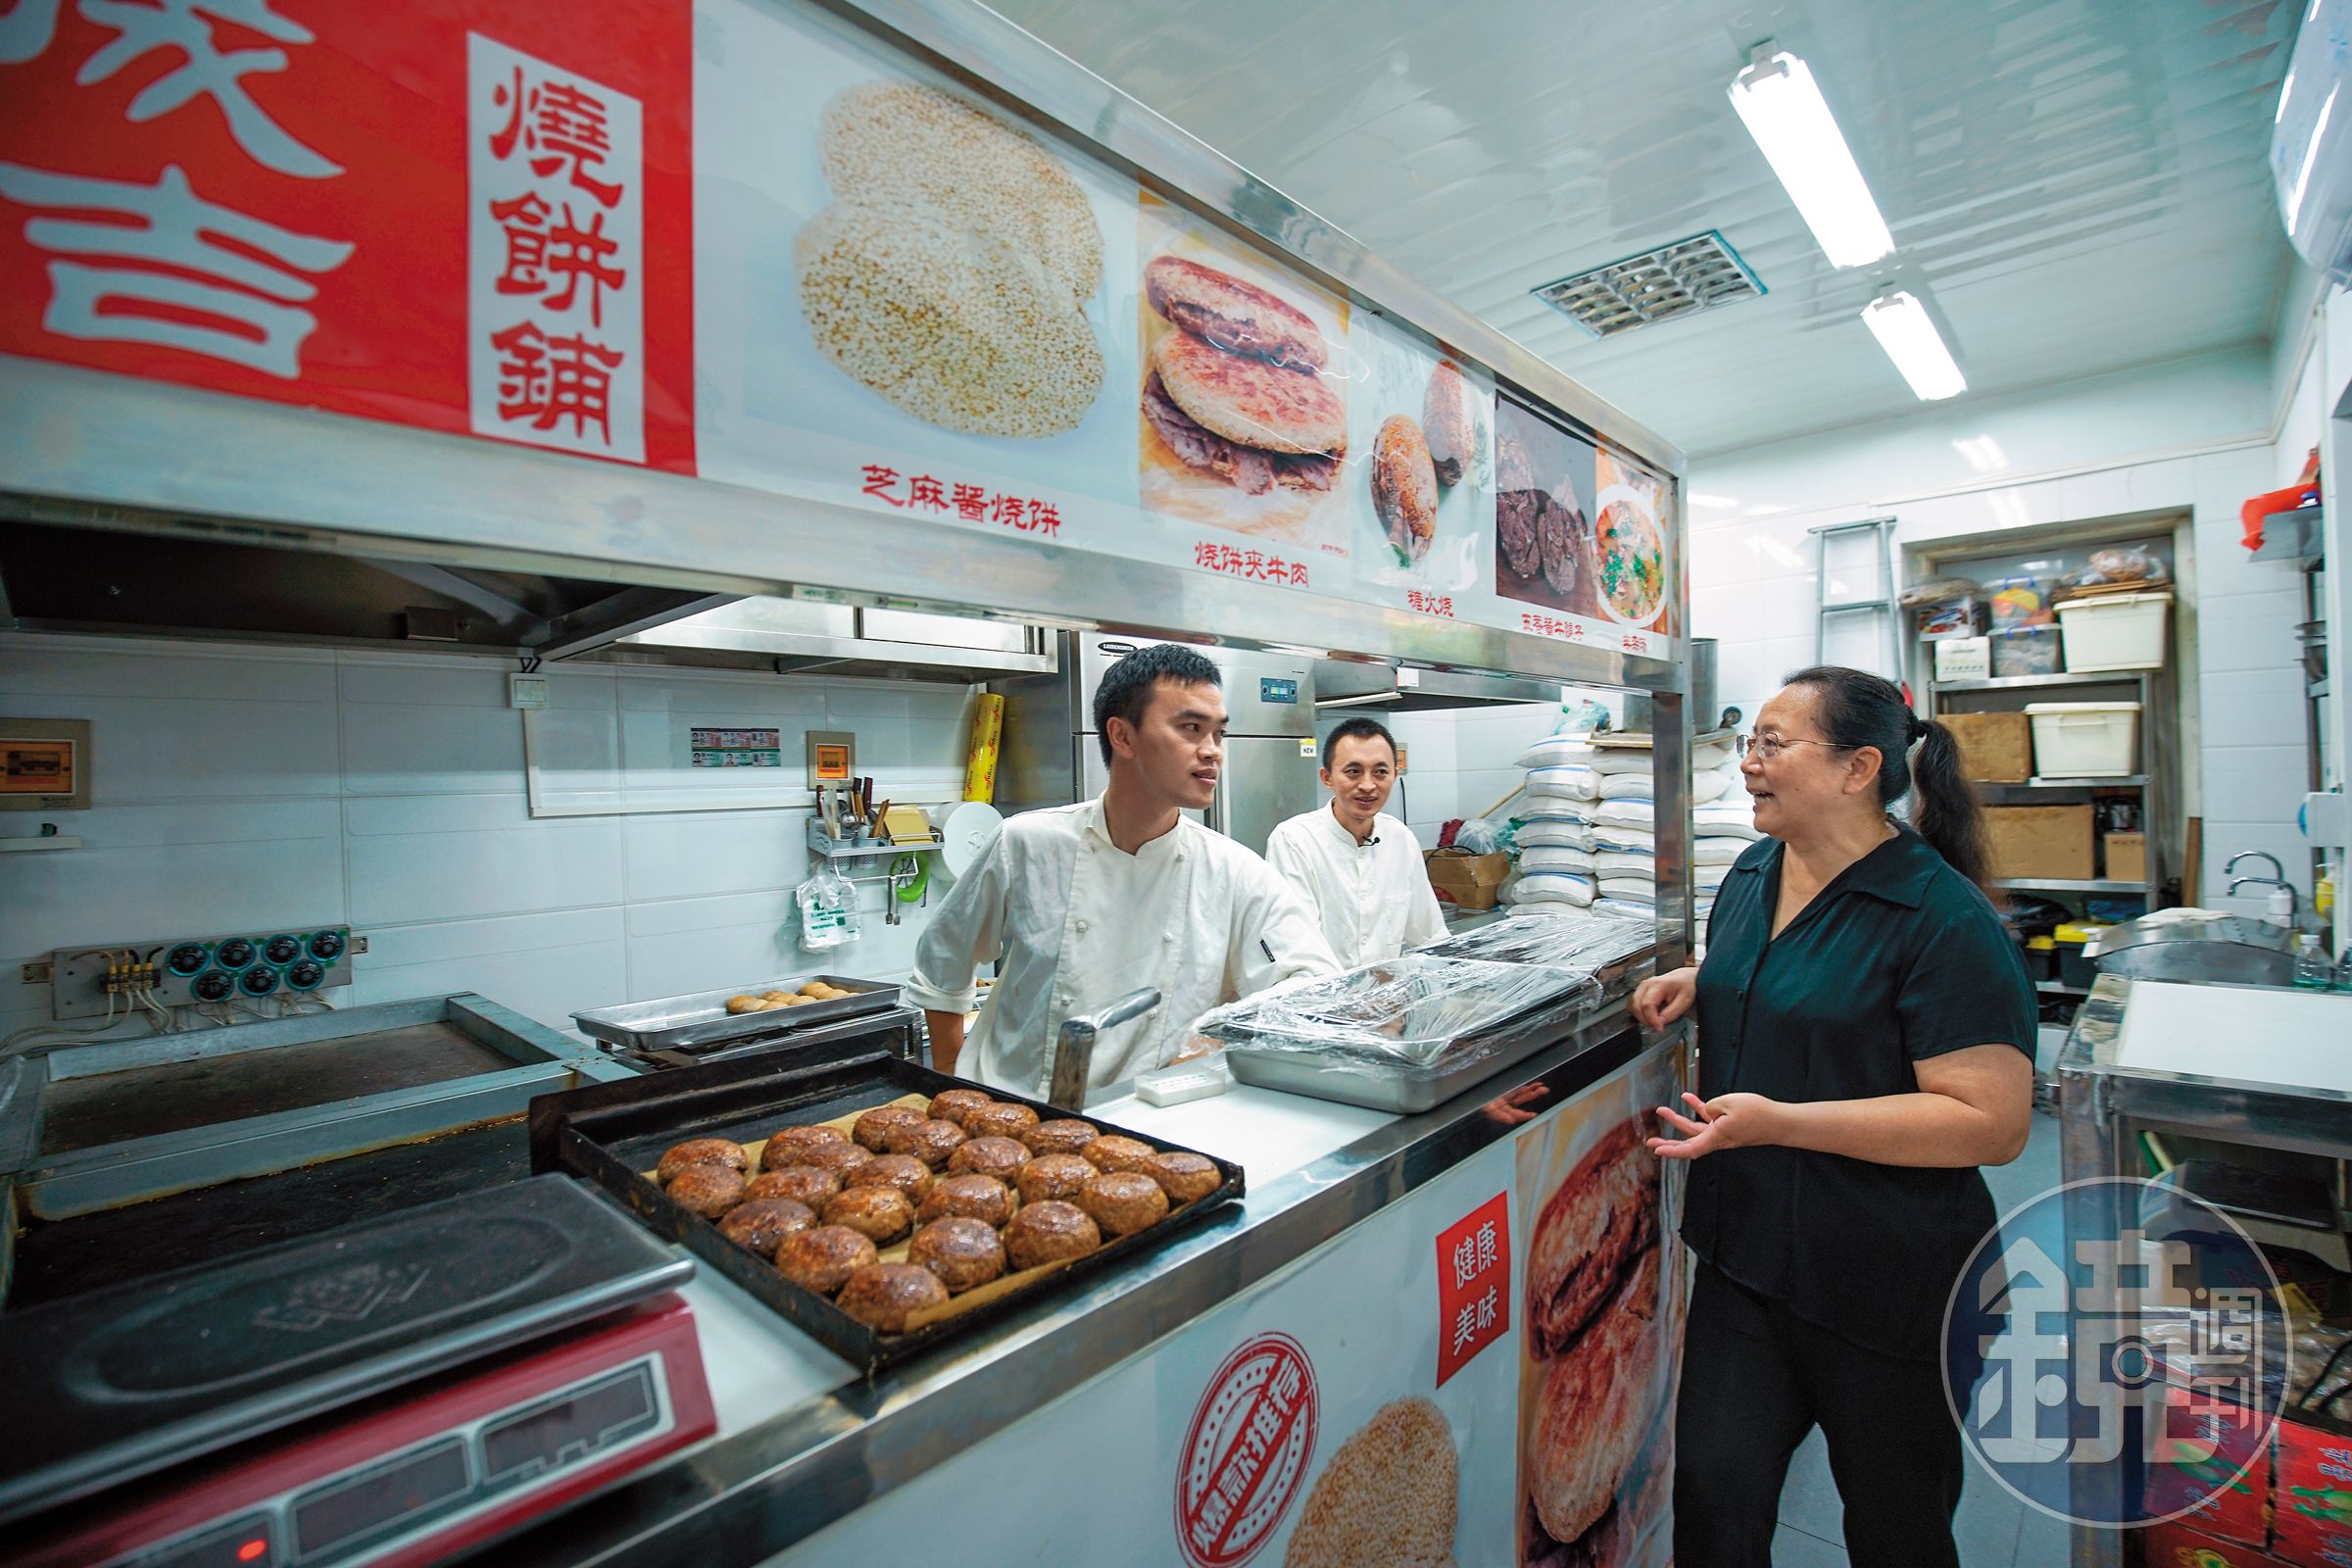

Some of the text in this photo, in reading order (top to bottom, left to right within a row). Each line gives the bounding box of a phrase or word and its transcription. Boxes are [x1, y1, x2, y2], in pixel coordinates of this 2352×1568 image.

[489, 65, 626, 447] 燒餅鋪
[1195, 540, 1309, 588] 烧饼夹牛肉
[1452, 1217, 1497, 1292] 健康
[1452, 1285, 1498, 1357] 美味
